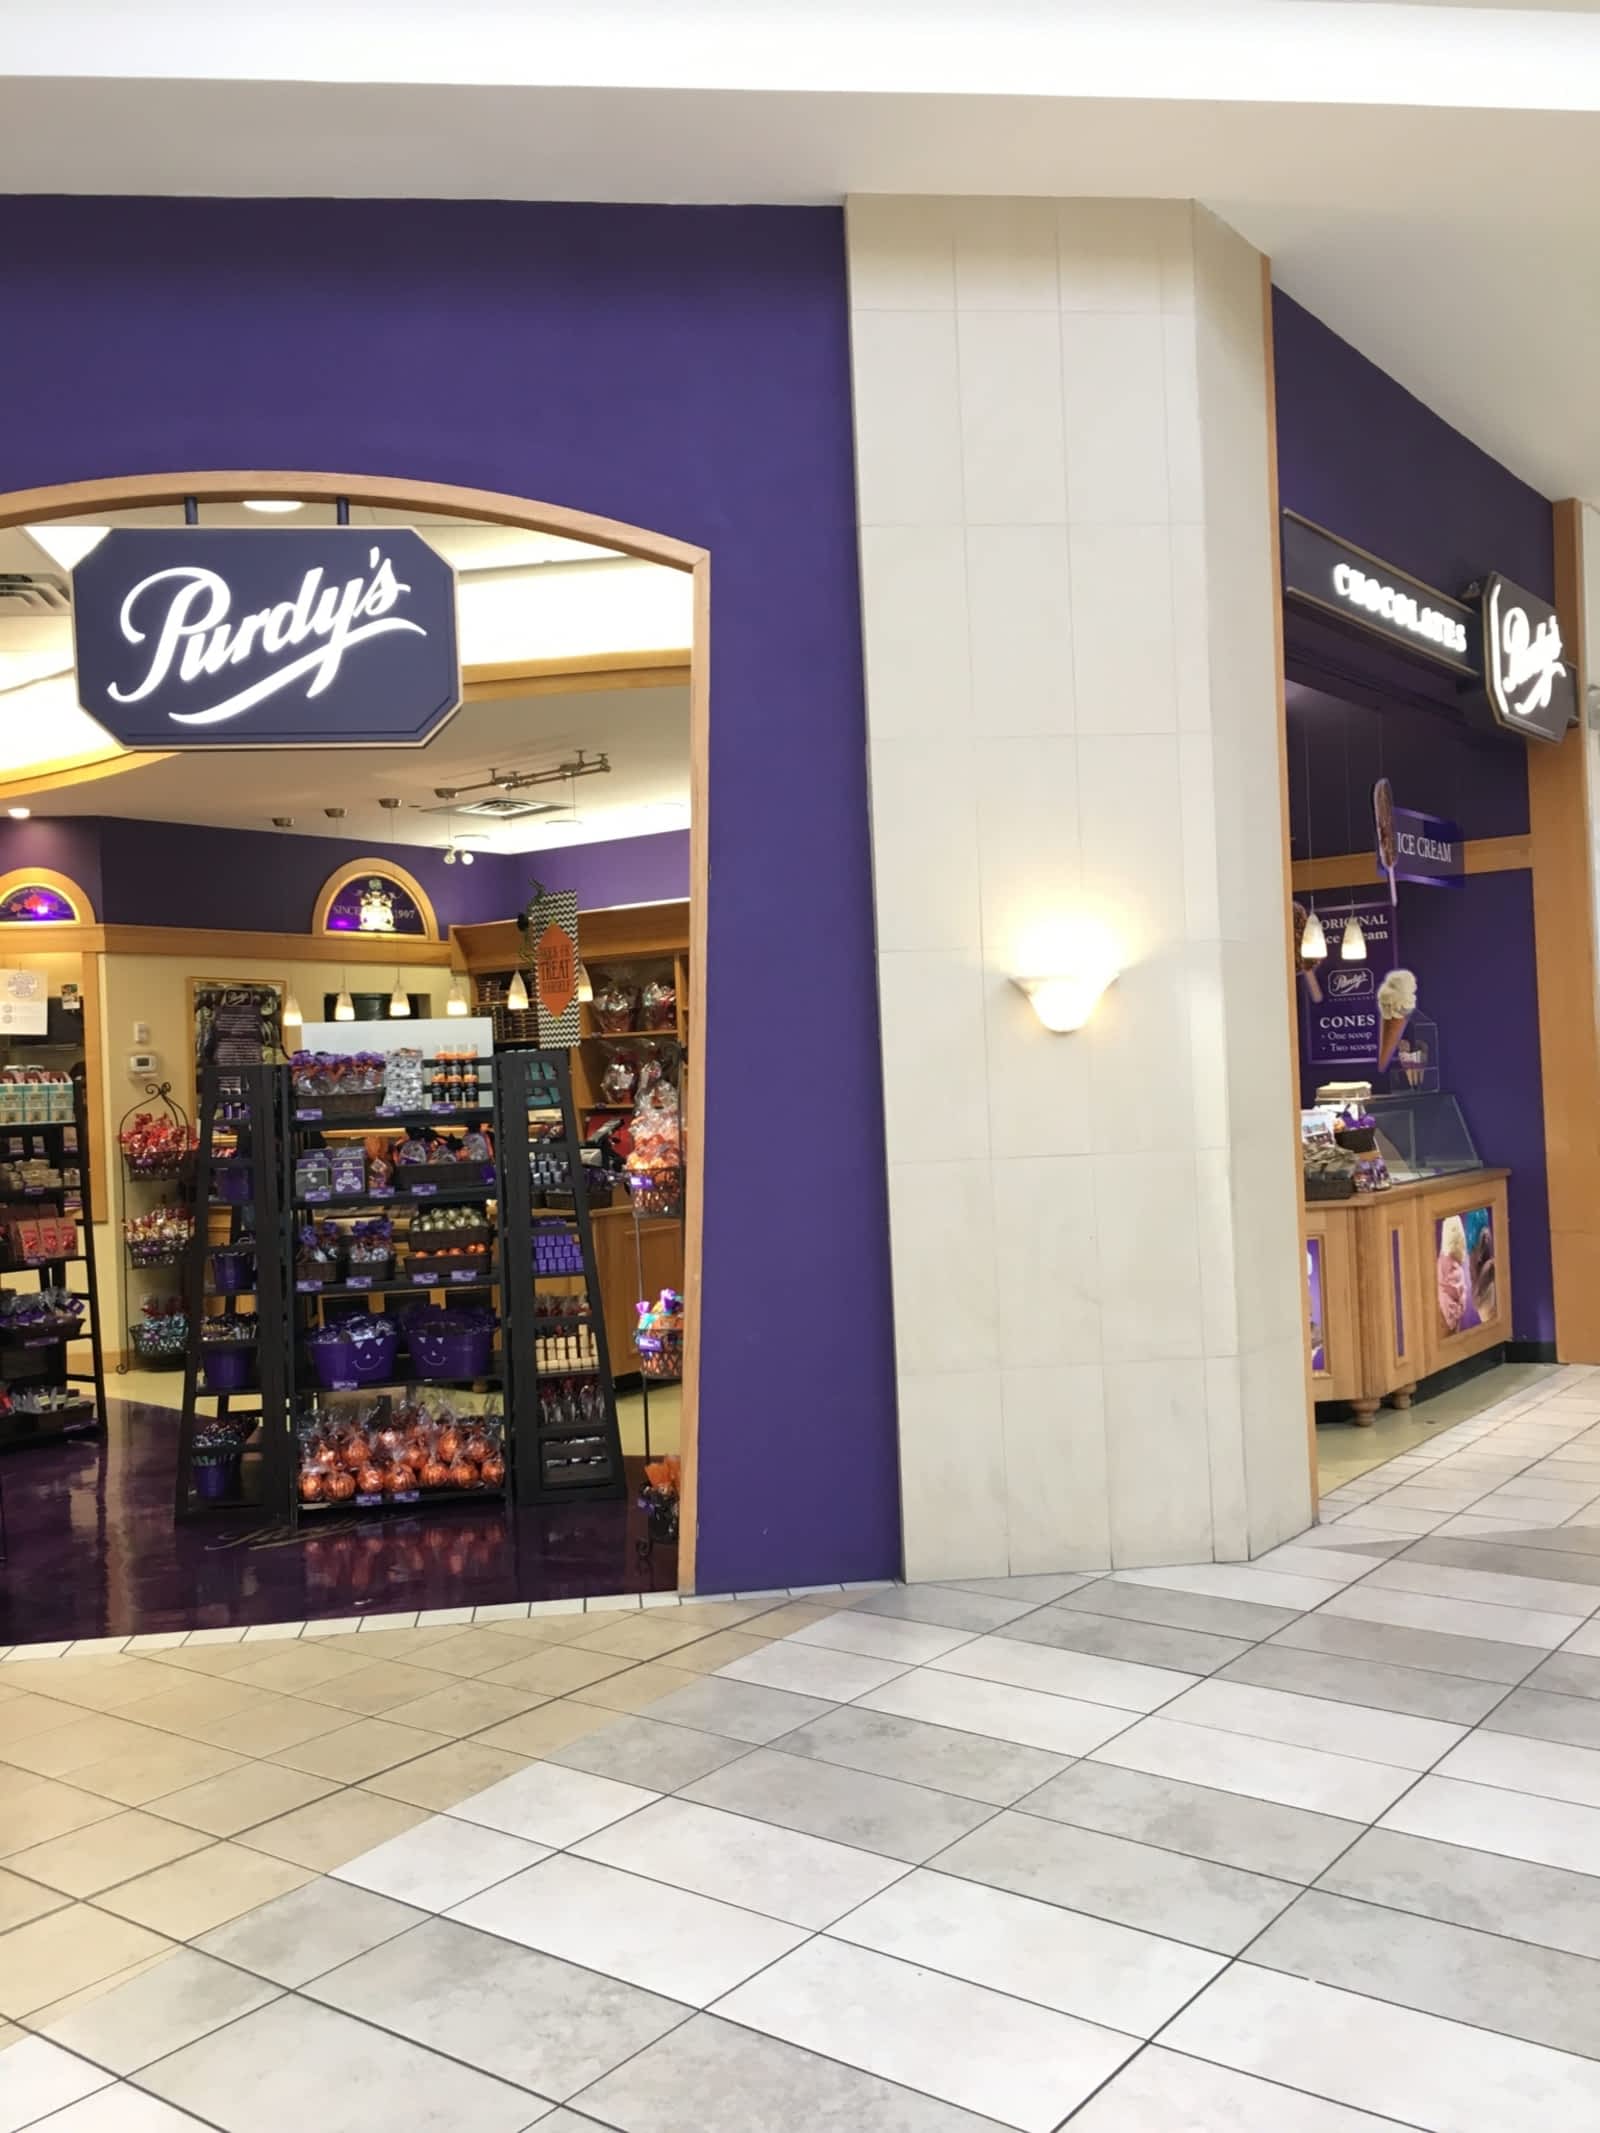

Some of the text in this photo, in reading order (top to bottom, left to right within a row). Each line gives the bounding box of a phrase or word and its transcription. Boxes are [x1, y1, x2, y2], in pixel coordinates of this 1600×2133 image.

[1333, 563, 1467, 652] CHOCOLATES
[107, 546, 427, 724] Purdy's
[1397, 832, 1452, 863] ICE CREAM
[1319, 1014, 1376, 1029] CONES
[1327, 1031, 1346, 1041] One
[1329, 1043, 1348, 1053] Two
